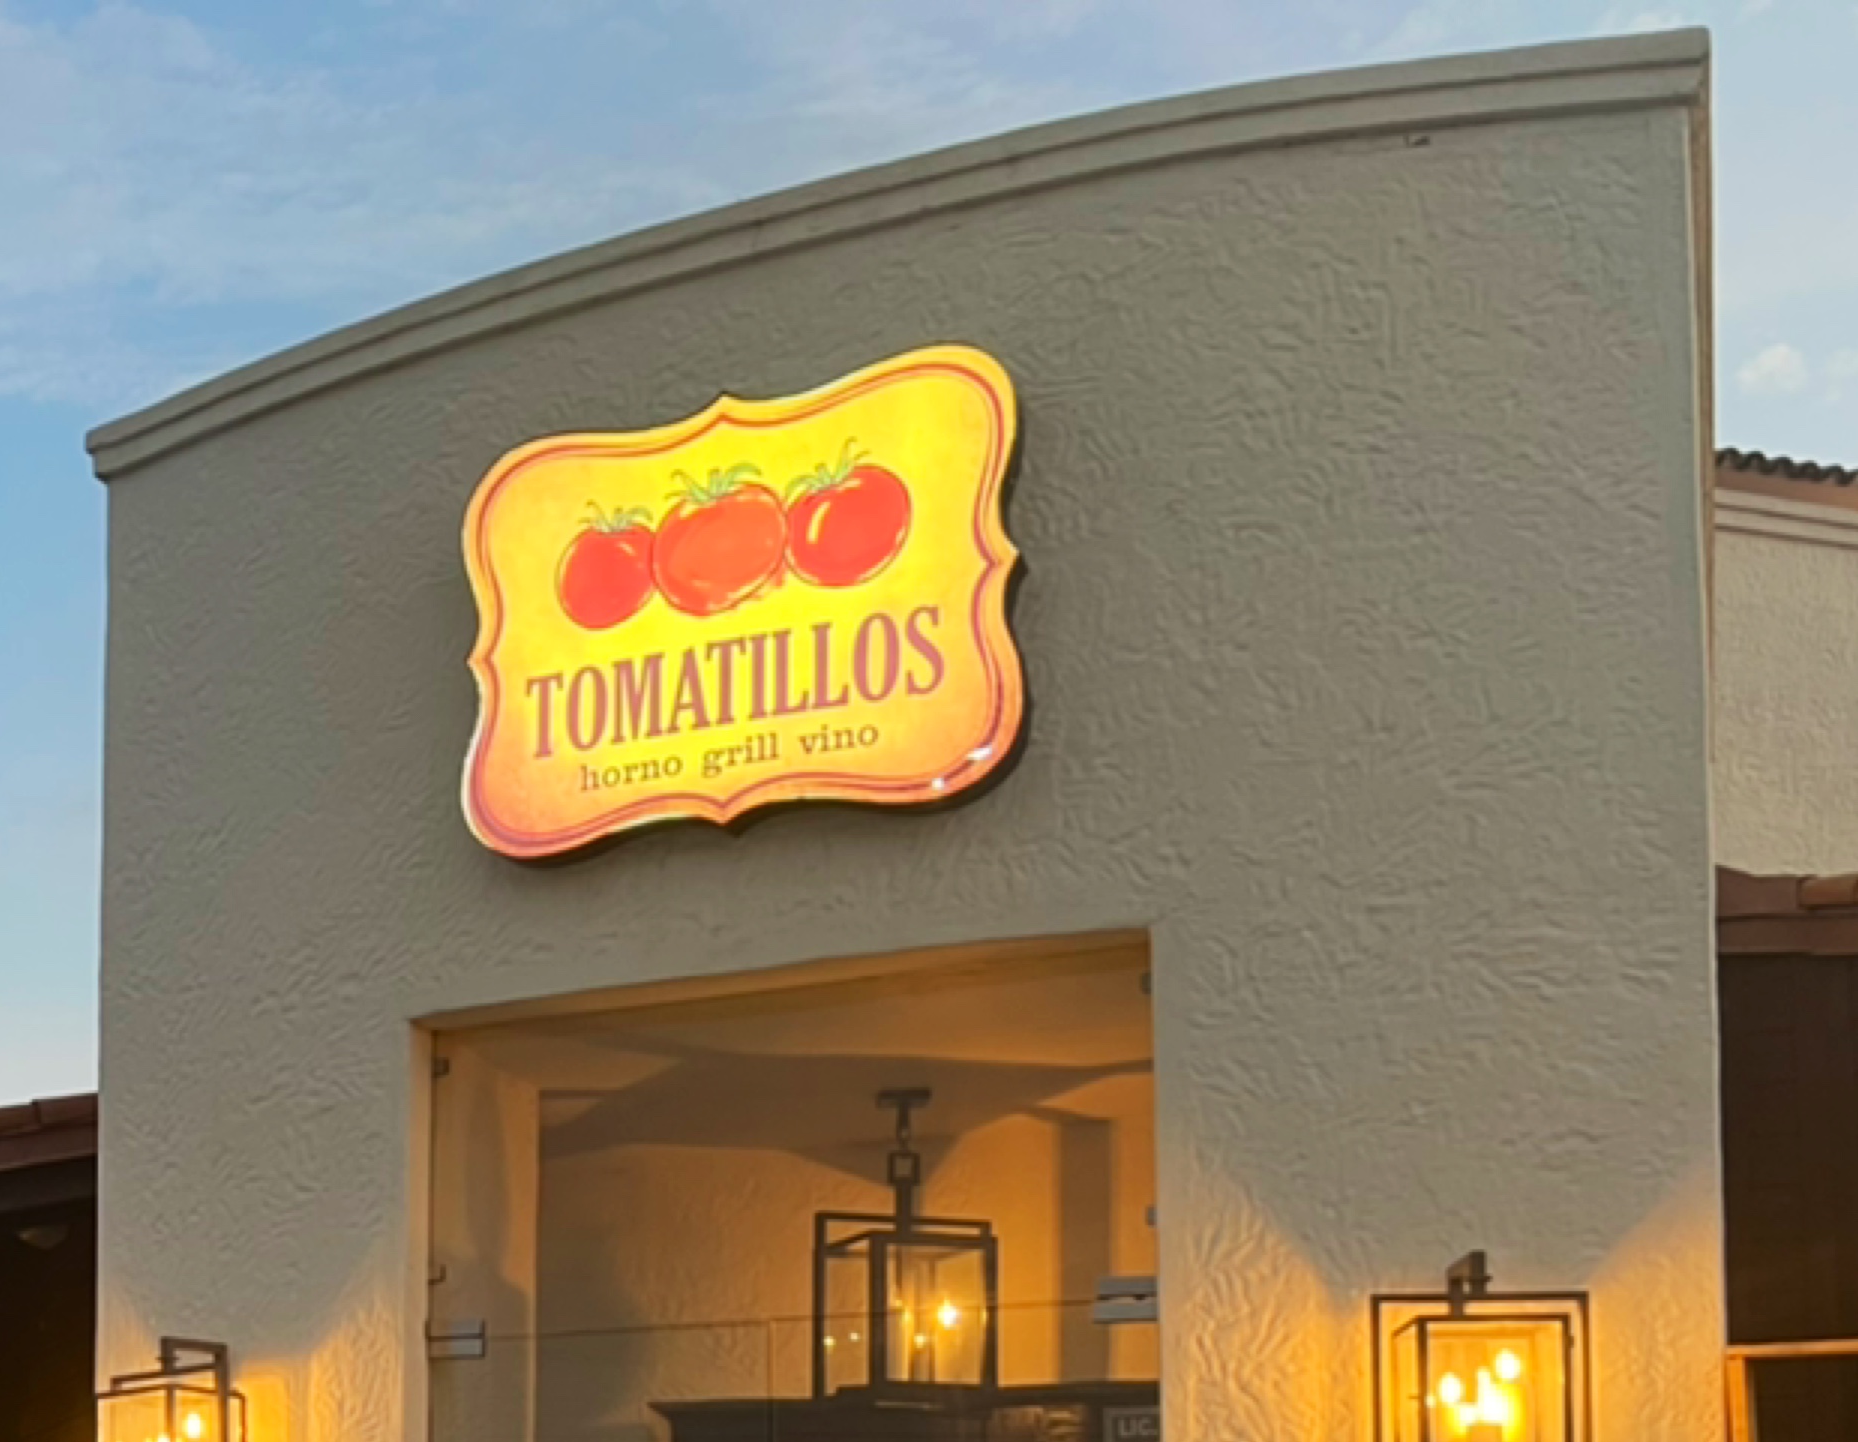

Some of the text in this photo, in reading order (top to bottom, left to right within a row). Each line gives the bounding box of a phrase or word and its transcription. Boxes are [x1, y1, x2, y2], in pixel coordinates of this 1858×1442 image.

[526, 605, 945, 760] TOMATILLOS
[580, 720, 880, 792] horno grill vino
